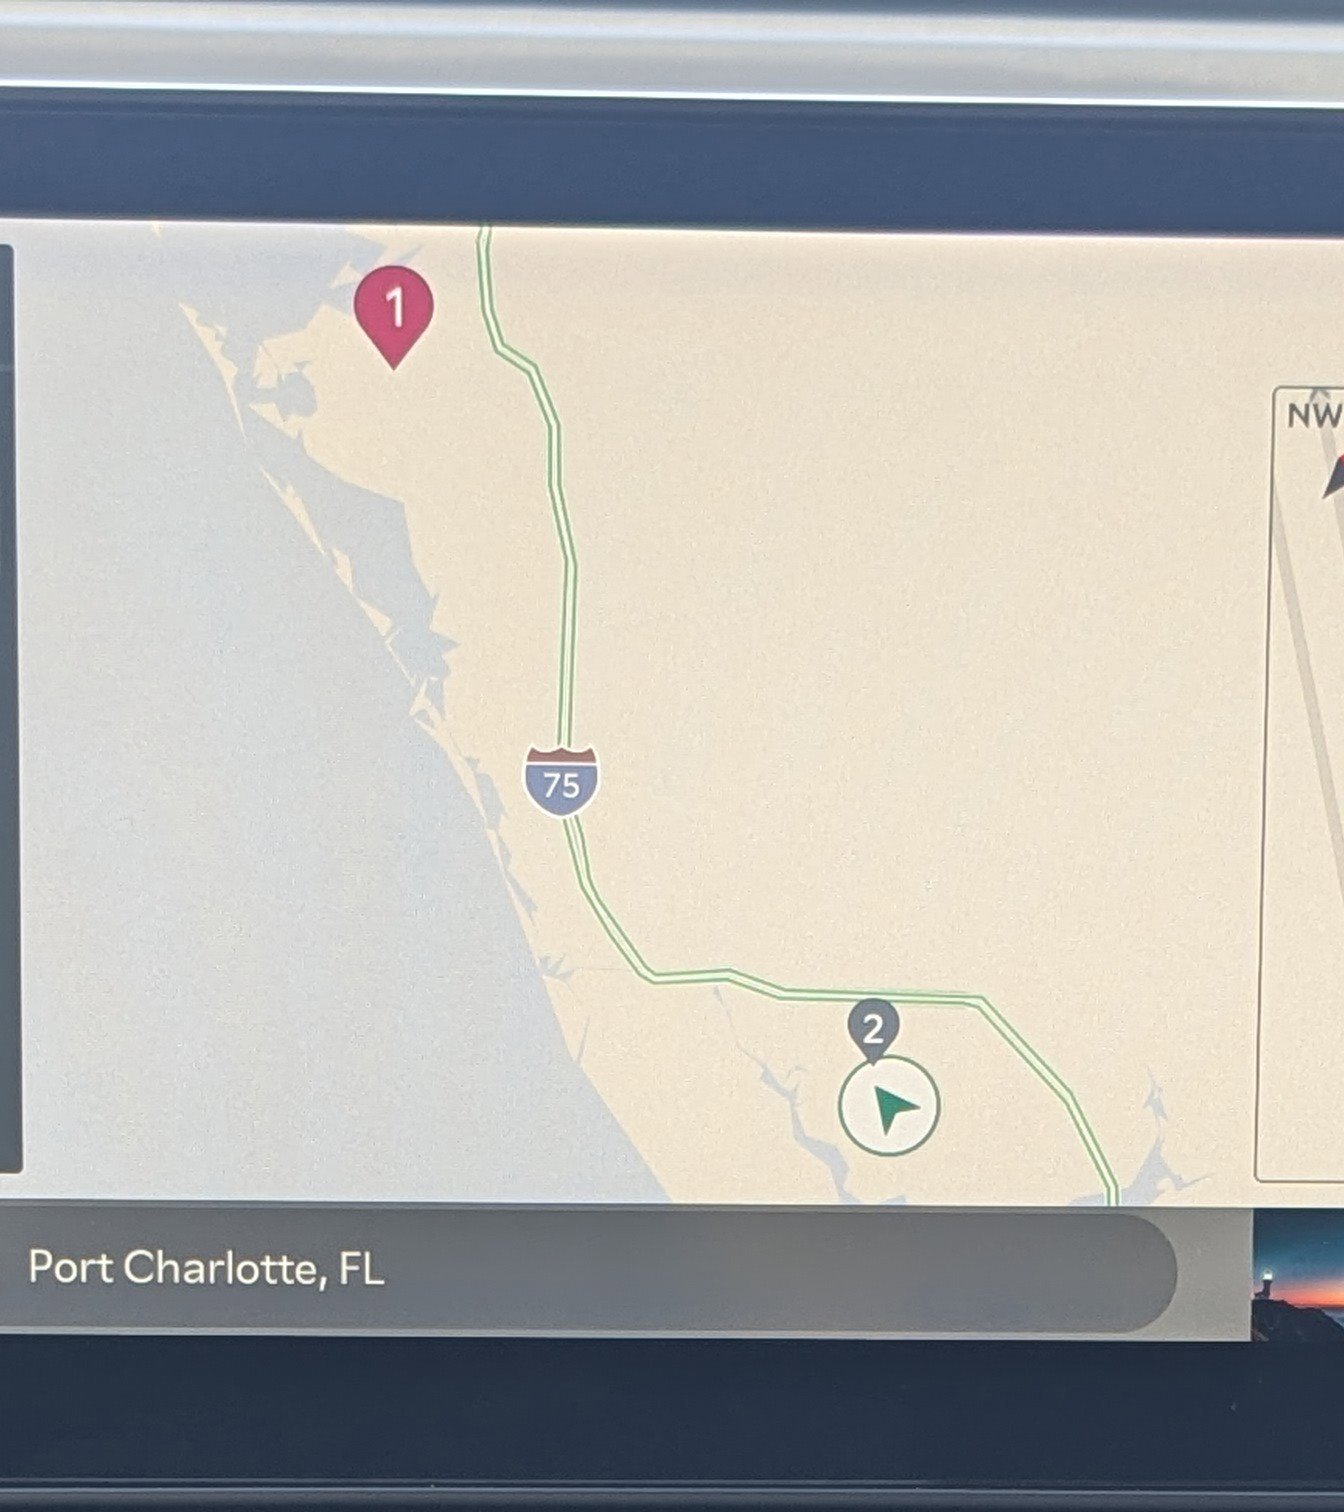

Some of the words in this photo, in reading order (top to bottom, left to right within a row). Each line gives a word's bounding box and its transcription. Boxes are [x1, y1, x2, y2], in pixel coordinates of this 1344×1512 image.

[384, 287, 403, 327] 1
[1287, 401, 1343, 429] NW
[543, 773, 579, 800] 75
[861, 1013, 885, 1045] 2
[28, 1249, 116, 1284] Port
[123, 1251, 328, 1292] Charlotte,
[339, 1251, 385, 1286] FL
